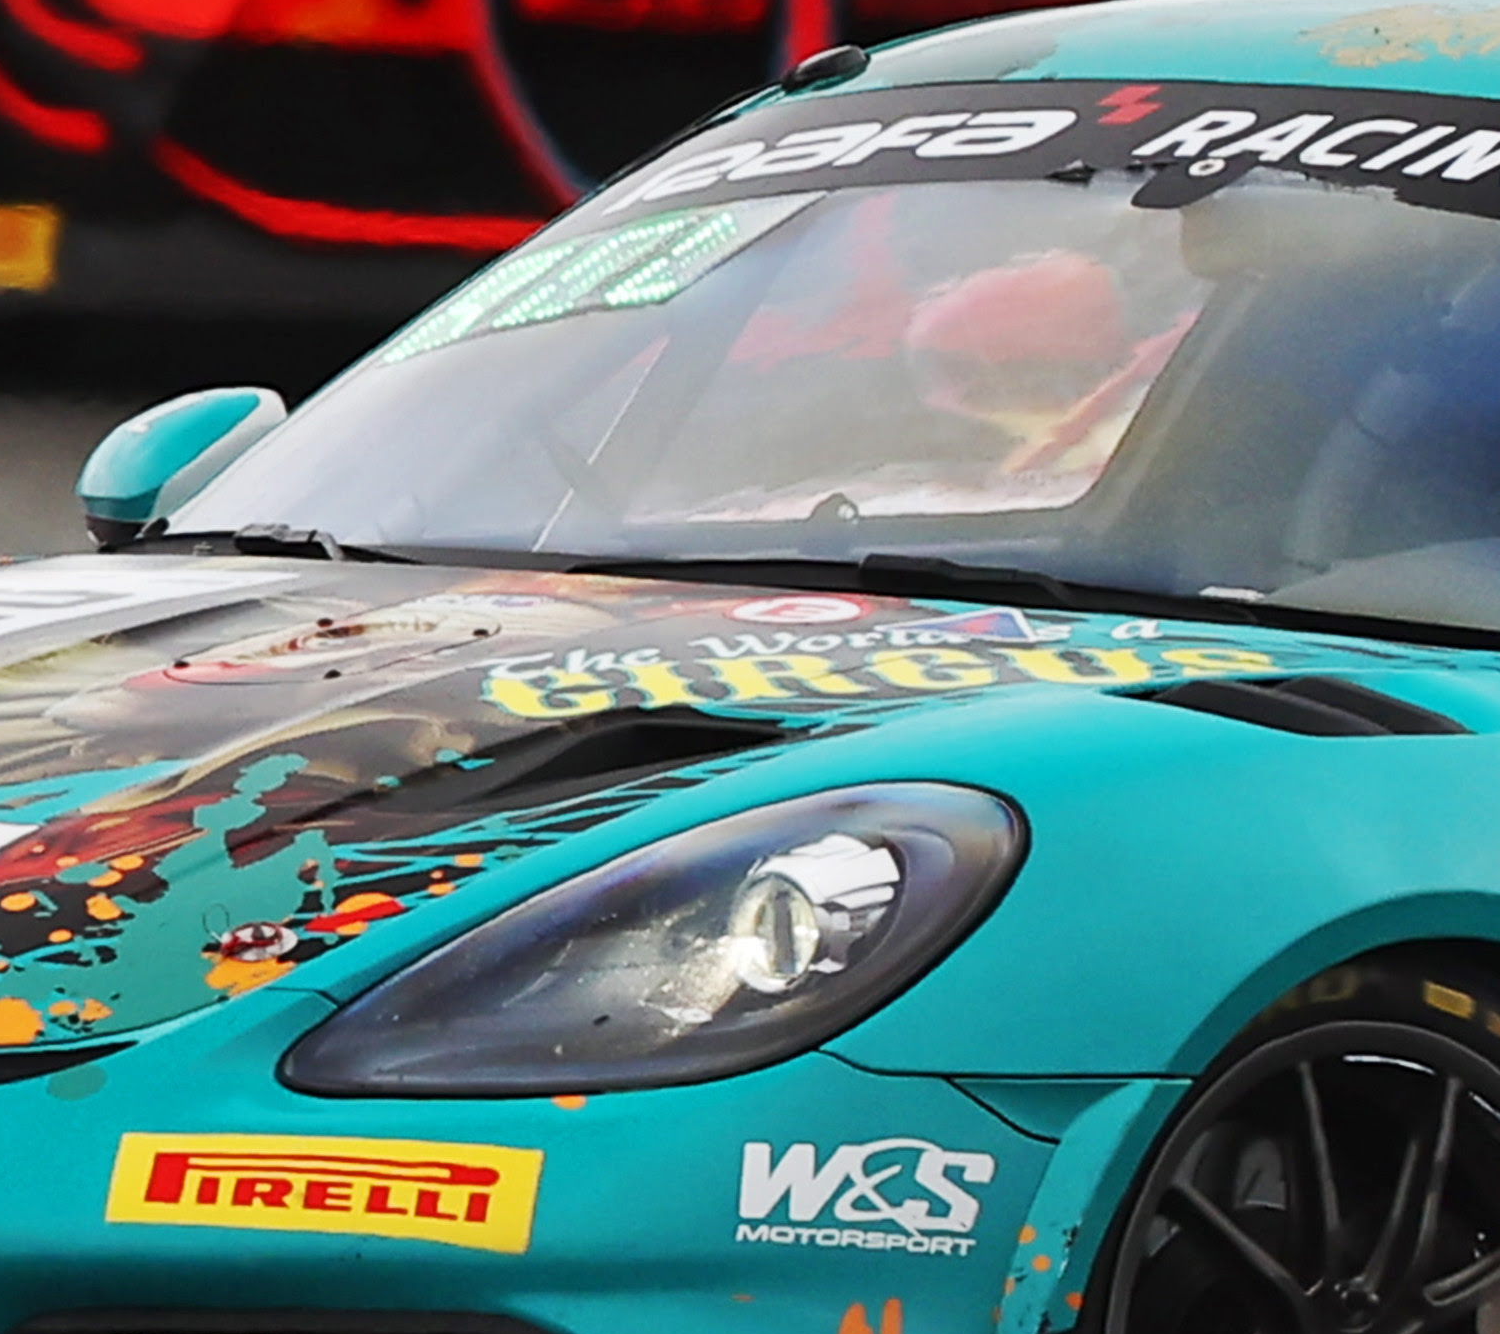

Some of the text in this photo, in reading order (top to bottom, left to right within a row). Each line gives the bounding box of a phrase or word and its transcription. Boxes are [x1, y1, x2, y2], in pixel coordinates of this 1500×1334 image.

[480, 645, 1278, 719] CIRCUS
[144, 1151, 500, 1223] PIRELLI
[739, 1137, 995, 1233] W&S
[735, 1223, 976, 1257] MOTORSPORT
